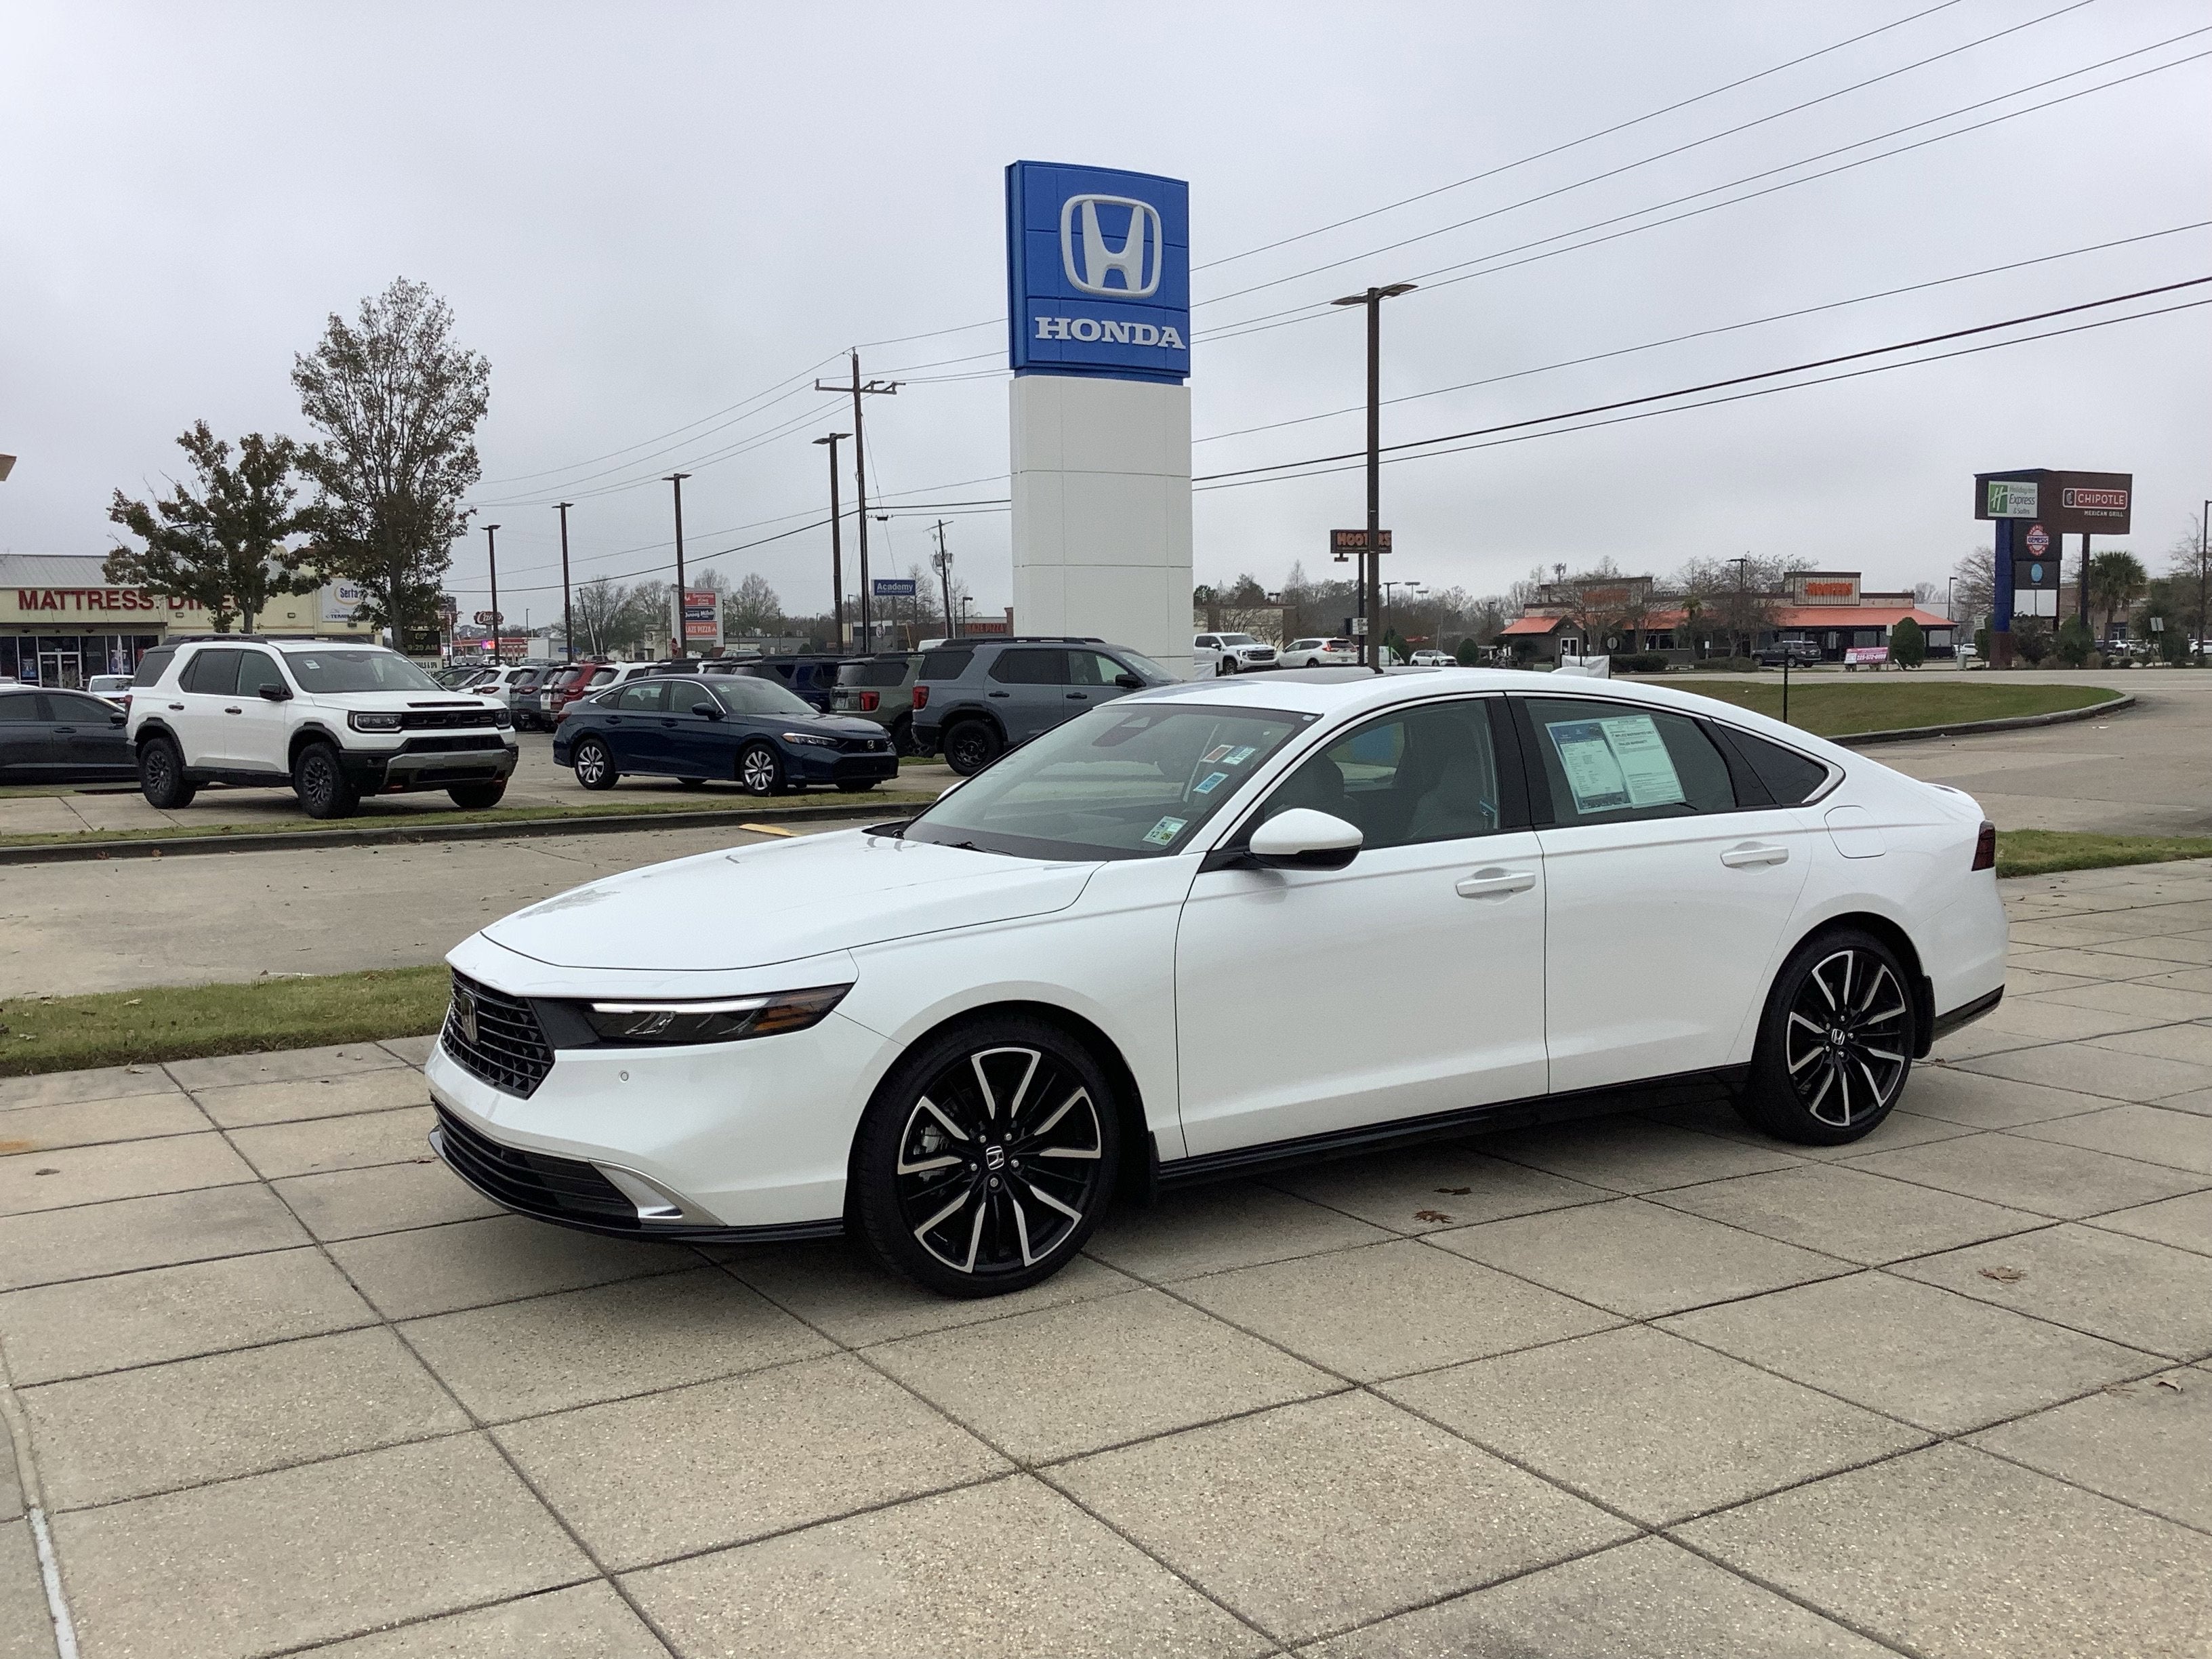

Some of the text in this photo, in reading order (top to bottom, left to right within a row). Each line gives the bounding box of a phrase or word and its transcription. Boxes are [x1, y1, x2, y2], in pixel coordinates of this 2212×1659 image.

[1035, 316, 1186, 350] HONDA
[2009, 493, 2036, 506] Express
[2078, 493, 2125, 505] CHIPOTLE
[340, 587, 359, 598] Serta
[877, 583, 914, 592] Academy
[18, 590, 155, 610] MATTRESS
